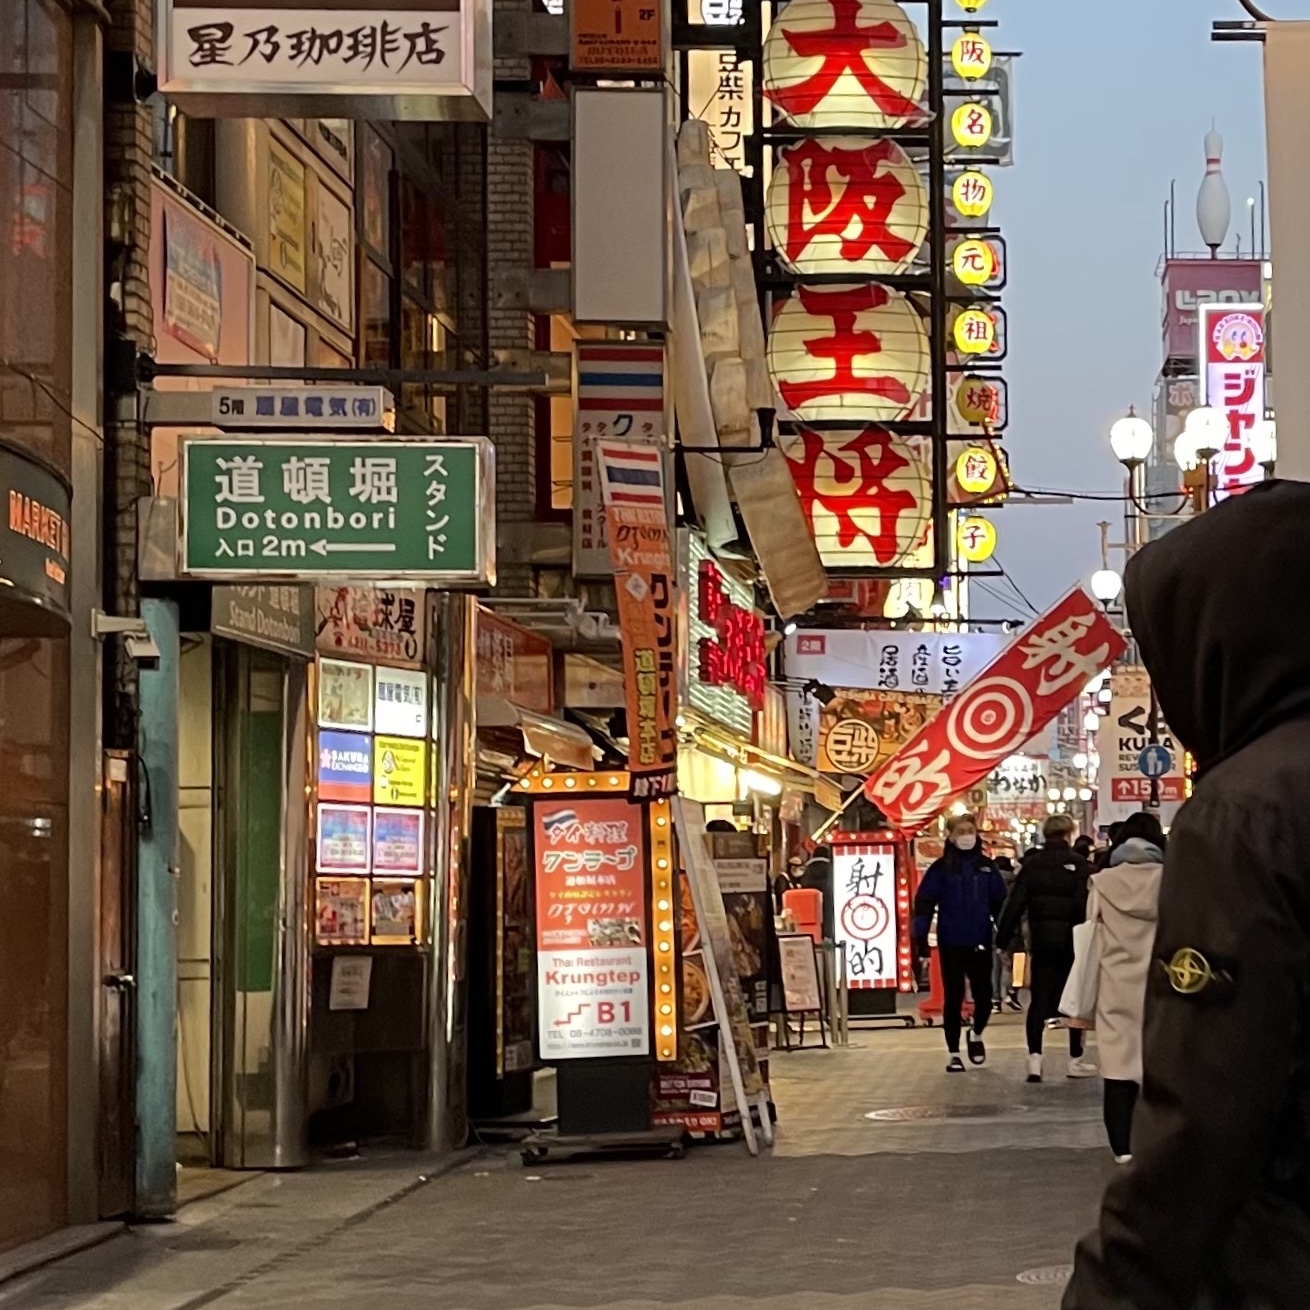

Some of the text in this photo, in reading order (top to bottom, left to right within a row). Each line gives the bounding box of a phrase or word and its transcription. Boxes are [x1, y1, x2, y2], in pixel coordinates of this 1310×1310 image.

[638, 9, 655, 20] 2F
[187, 19, 450, 73] 星乃珈琲店
[214, 455, 398, 504] 道頓堀
[215, 506, 397, 530] Dotonbori
[422, 454, 450, 559] スタンド
[214, 535, 306, 558] 入口 2m
[1118, 737, 1175, 752] KUA
[331, 750, 369, 763] SAKURA
[845, 856, 884, 977] 射的
[552, 957, 631, 968] Thai Restaurant
[545, 970, 640, 987] Krungtep
[597, 1001, 631, 1024] B1
